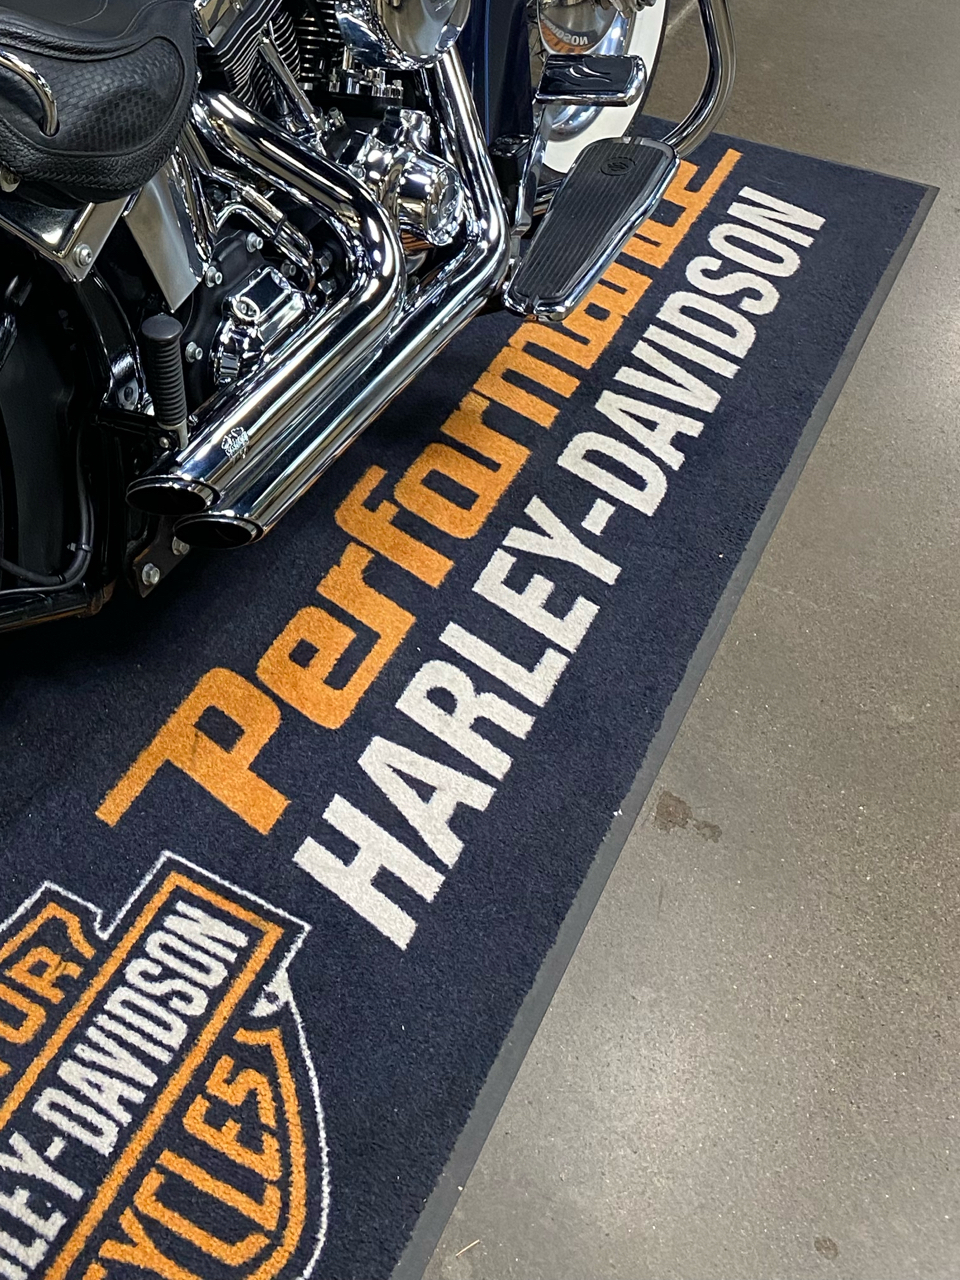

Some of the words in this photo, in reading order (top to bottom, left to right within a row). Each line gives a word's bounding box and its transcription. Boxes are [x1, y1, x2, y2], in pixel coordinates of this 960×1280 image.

[96, 148, 743, 835] Performance
[292, 186, 827, 950] HARLEY-DAVIDSON
[82, 1054, 281, 1280] YCLES
